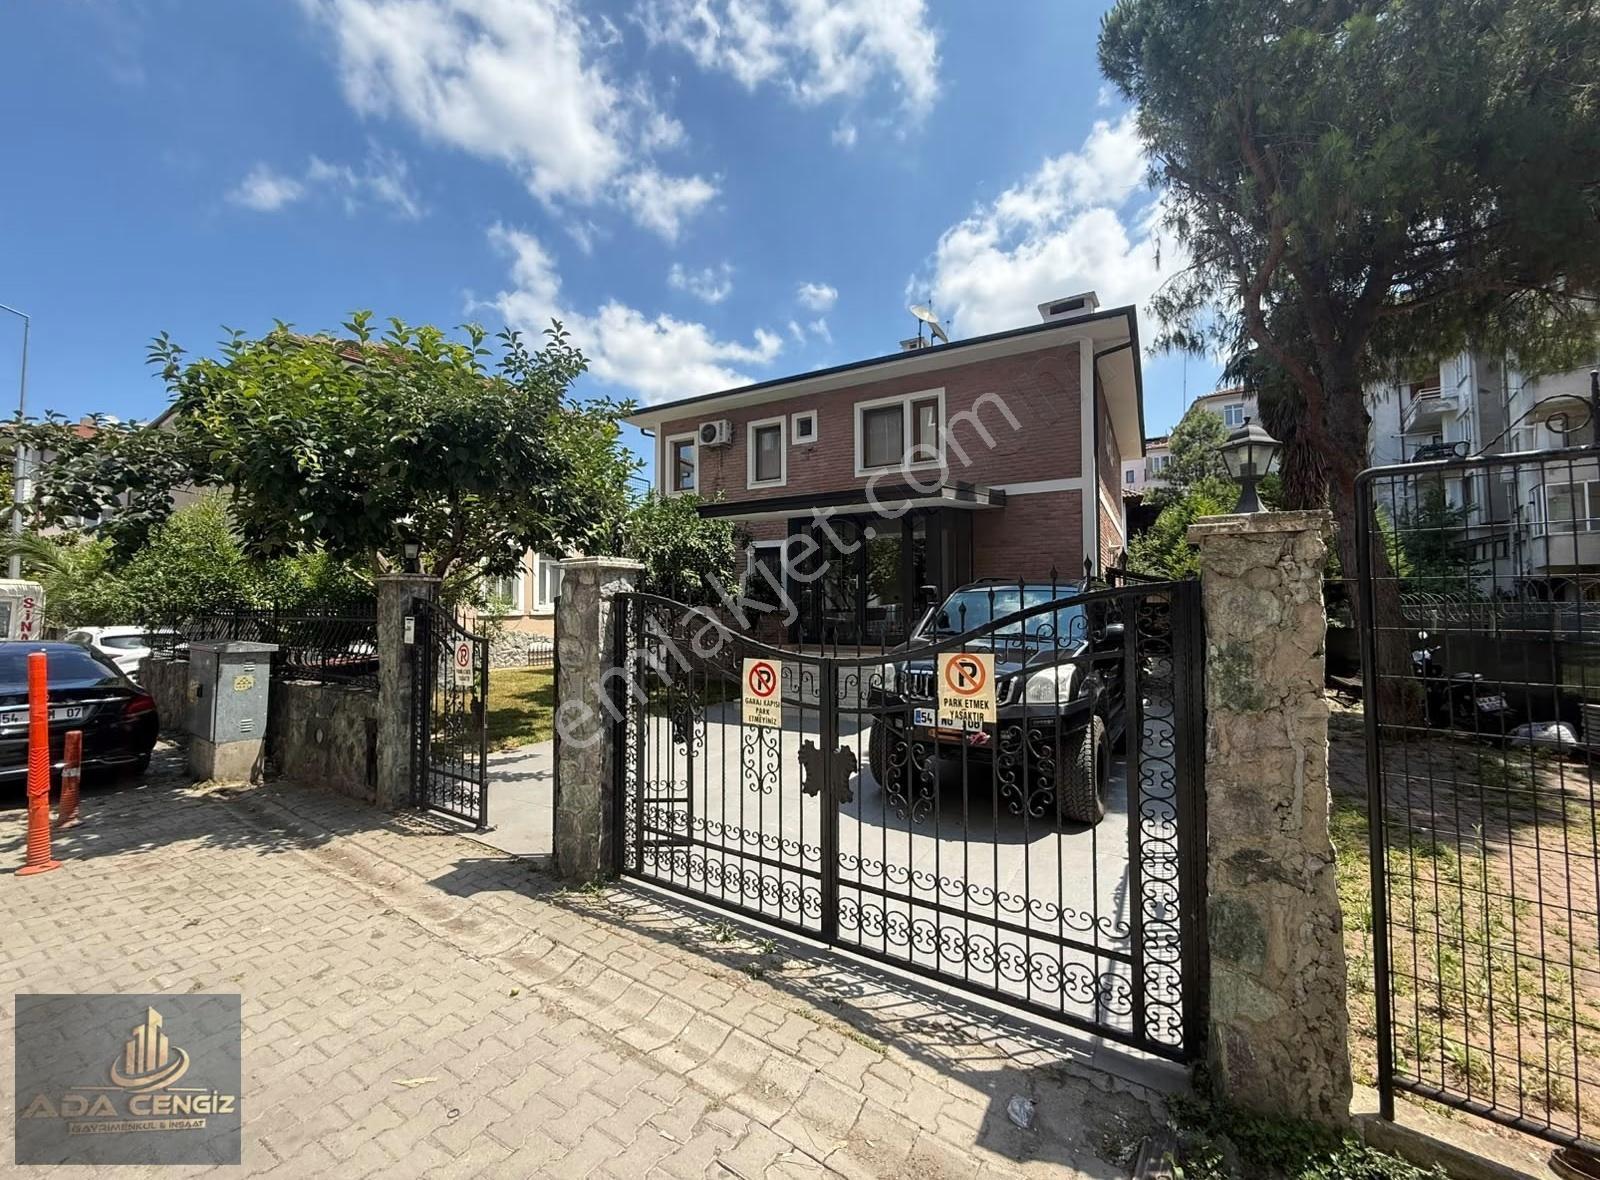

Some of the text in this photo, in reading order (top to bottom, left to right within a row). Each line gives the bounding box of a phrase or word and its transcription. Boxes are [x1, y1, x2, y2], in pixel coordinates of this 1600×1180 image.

[745, 698, 762, 706] GARAJ
[944, 698, 989, 710] PARK ETMEK
[2, 713, 18, 724] 54
[66, 708, 81, 718] 07
[756, 708, 770, 716] PARK
[950, 711, 984, 721] YASAKTIR
[921, 712, 933, 723] 54
